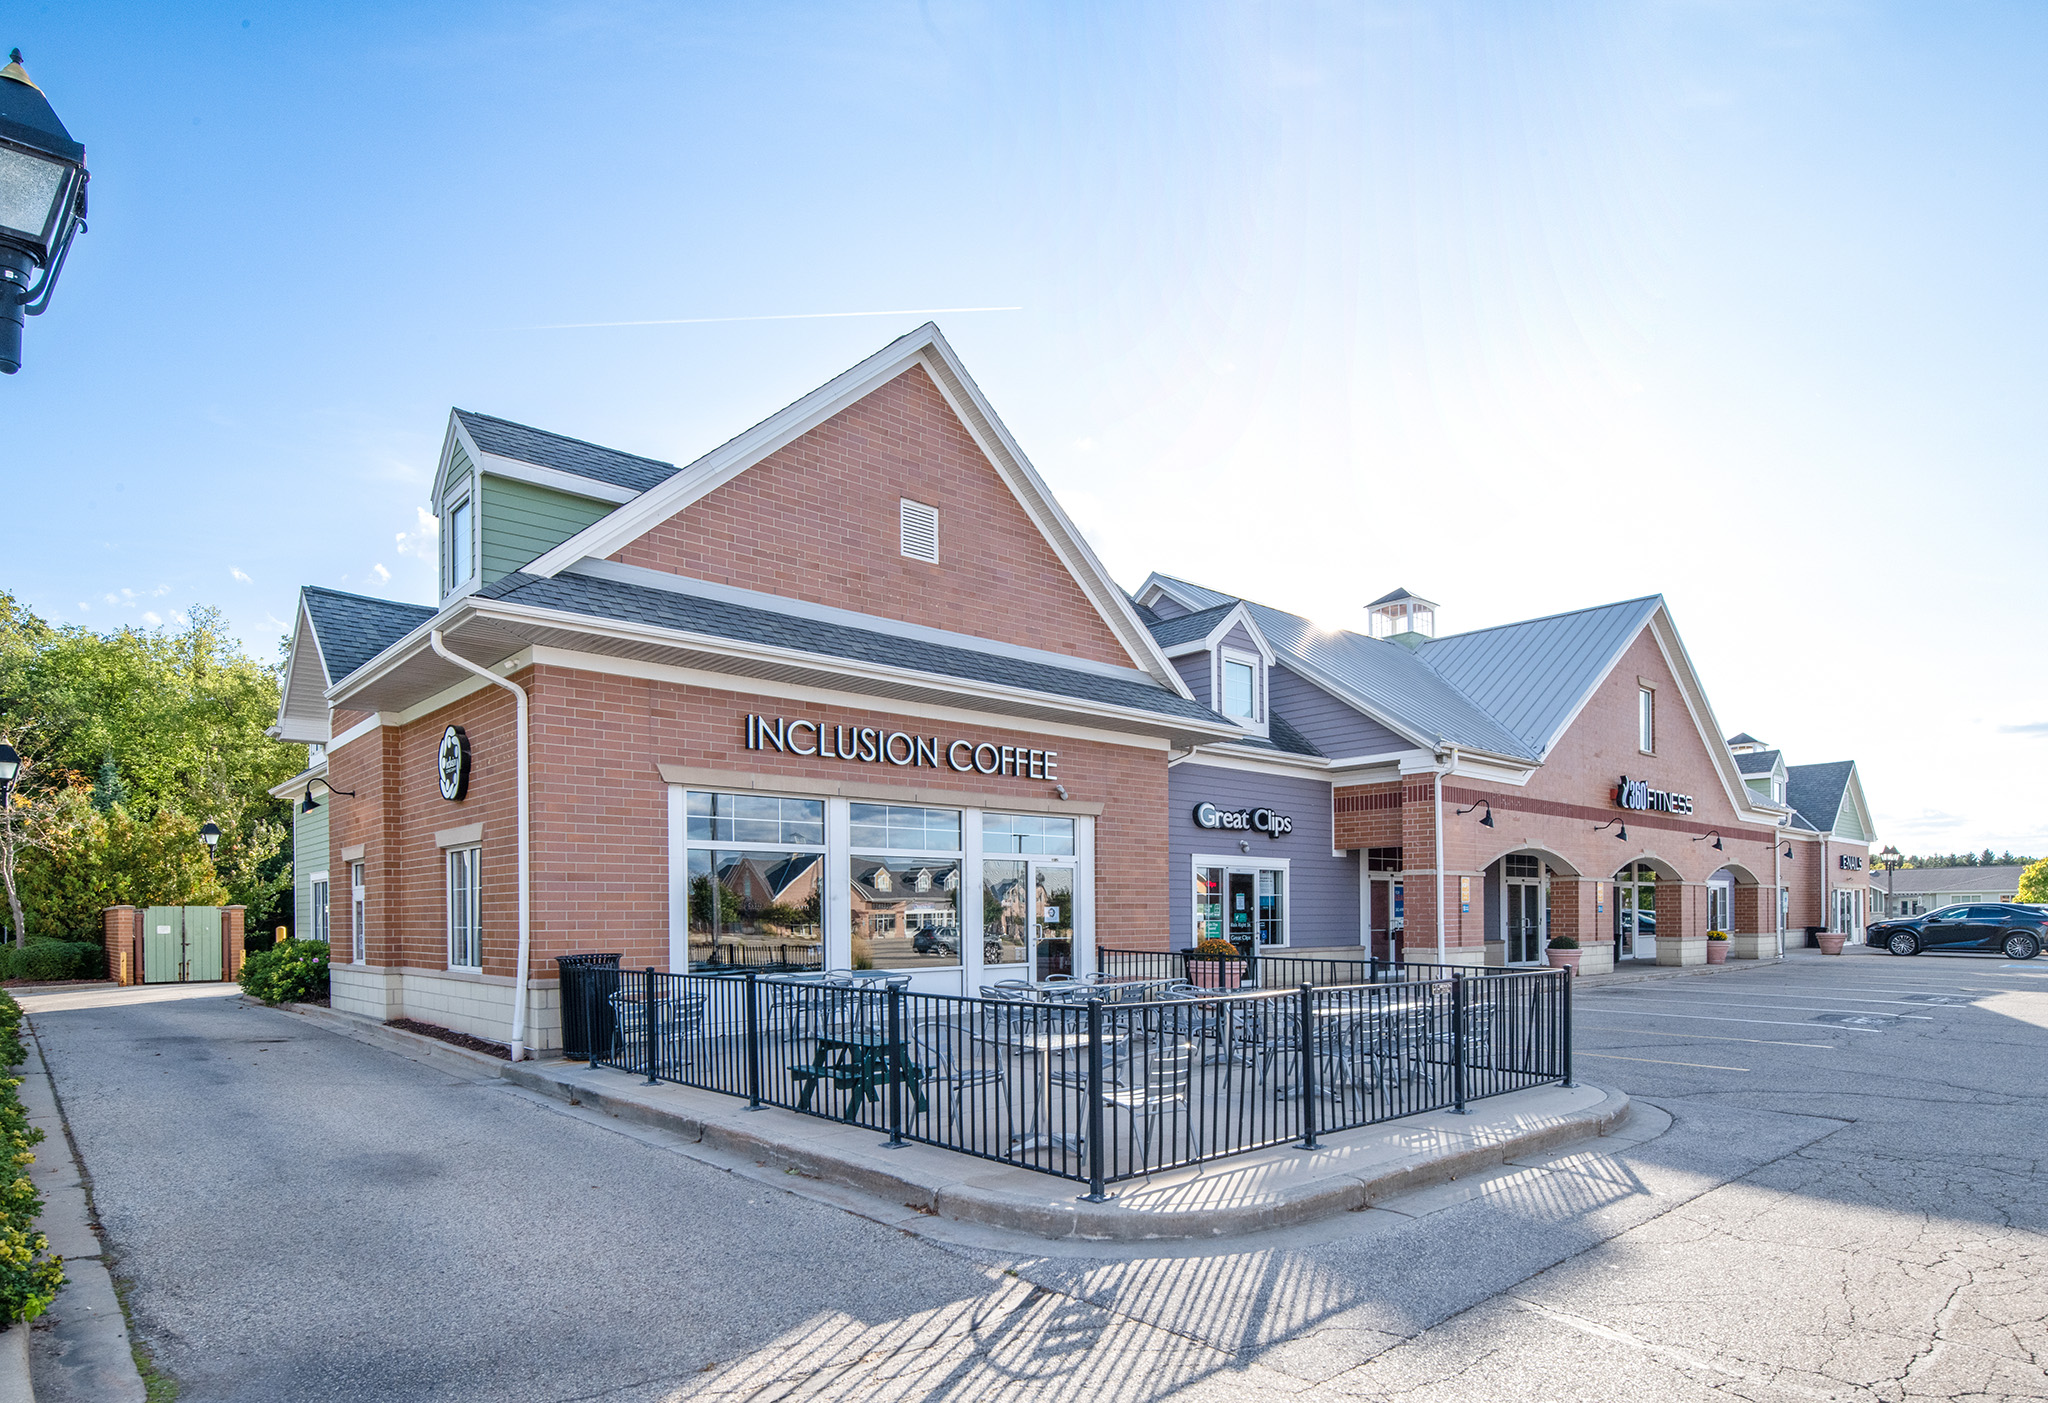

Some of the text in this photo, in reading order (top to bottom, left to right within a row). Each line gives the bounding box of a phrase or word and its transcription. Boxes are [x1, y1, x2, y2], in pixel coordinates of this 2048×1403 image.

[745, 714, 1058, 780] INCLUSION COFFEE
[1647, 788, 1693, 815] FITNESS
[1197, 802, 1292, 837] Great Clips
